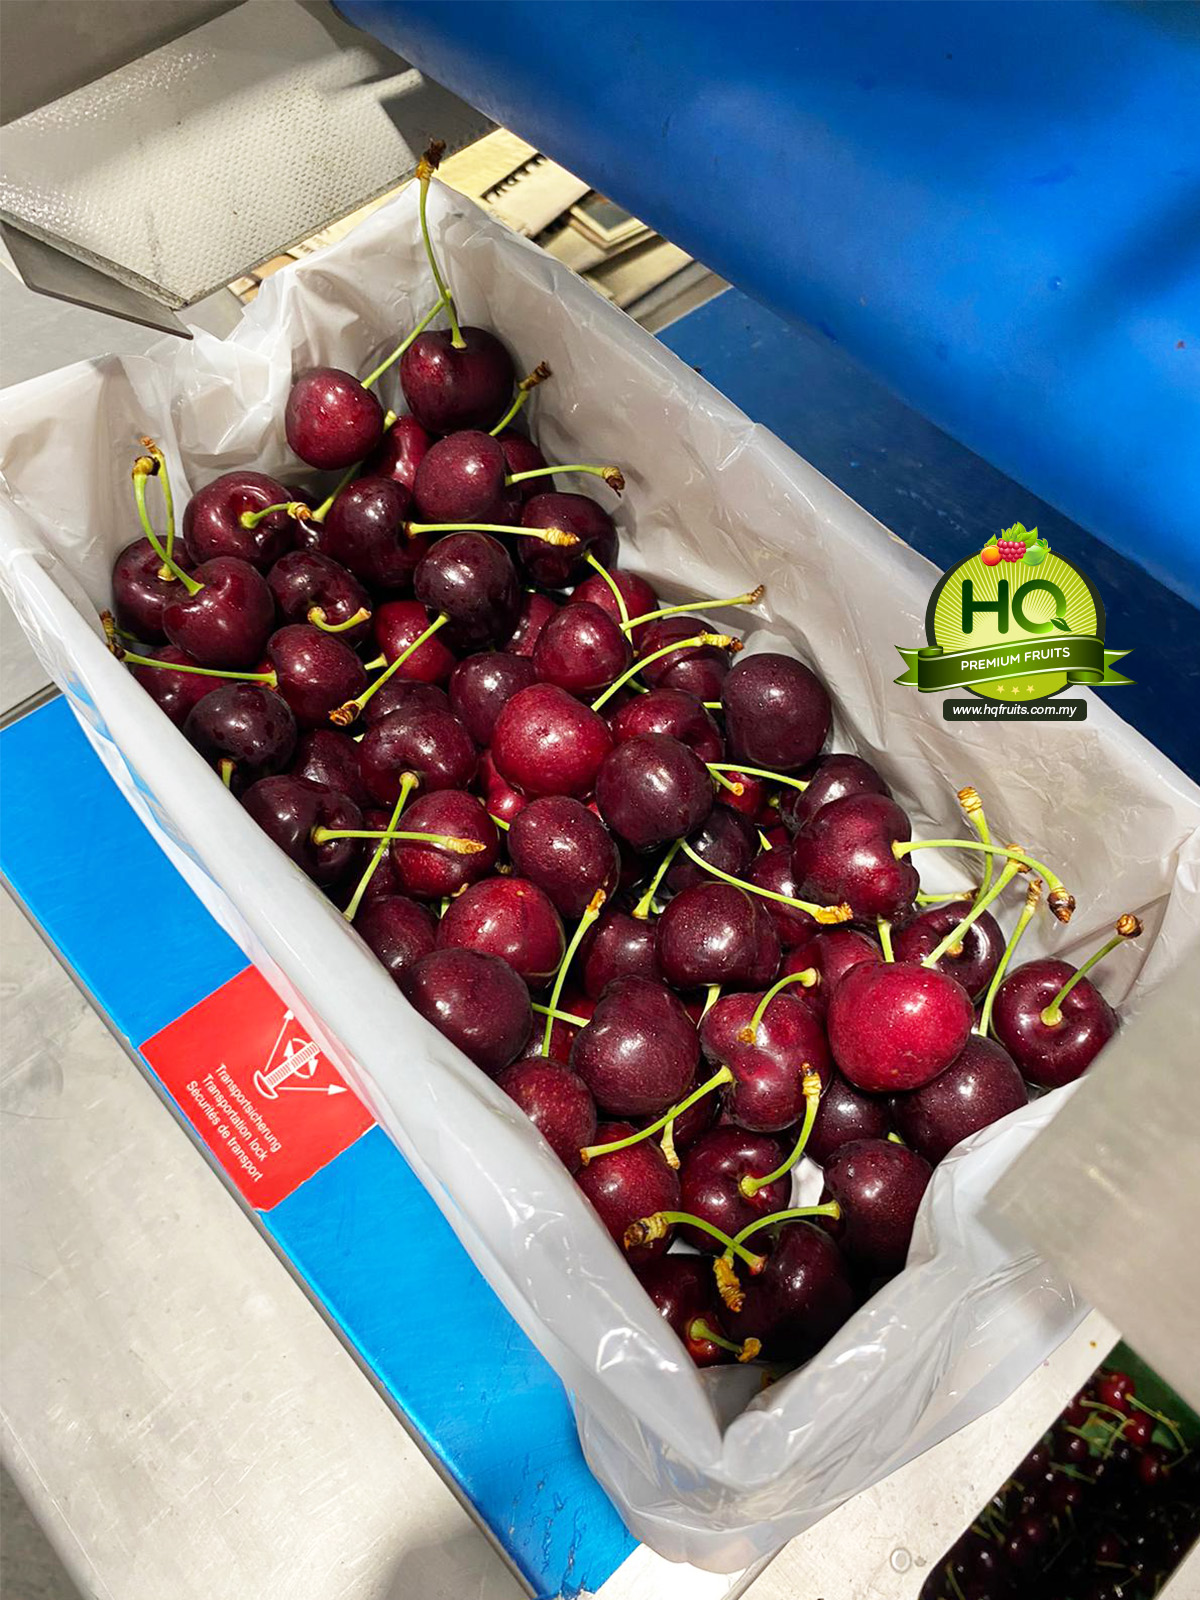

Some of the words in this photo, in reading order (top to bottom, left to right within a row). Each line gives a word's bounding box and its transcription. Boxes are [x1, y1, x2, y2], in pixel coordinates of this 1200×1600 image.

[202, 1073, 253, 1141] Transportation
[248, 1138, 268, 1162] lock
[215, 1063, 282, 1153] Transportsicherung
[217, 1124, 231, 1139] de
[227, 1137, 264, 1182] transport
